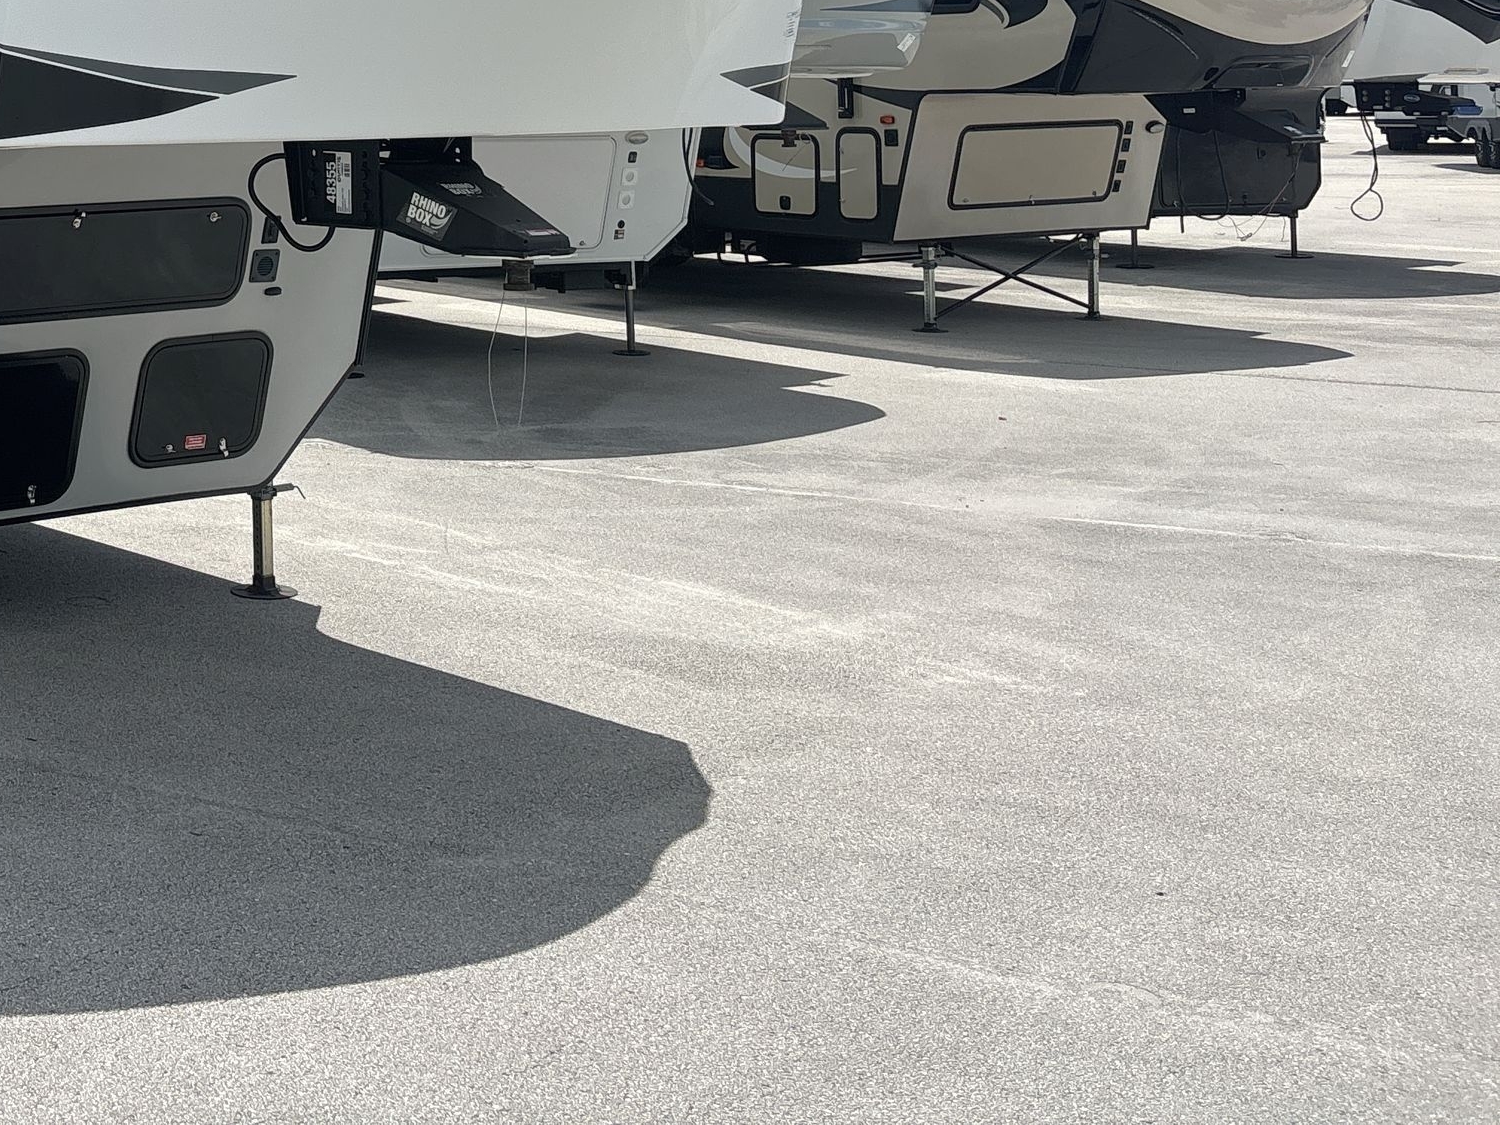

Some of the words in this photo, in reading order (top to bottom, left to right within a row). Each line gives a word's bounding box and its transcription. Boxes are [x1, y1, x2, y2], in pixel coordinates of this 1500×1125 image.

[325, 161, 337, 204] 48355
[407, 203, 433, 227] BOX
[410, 191, 447, 219] RHINO
